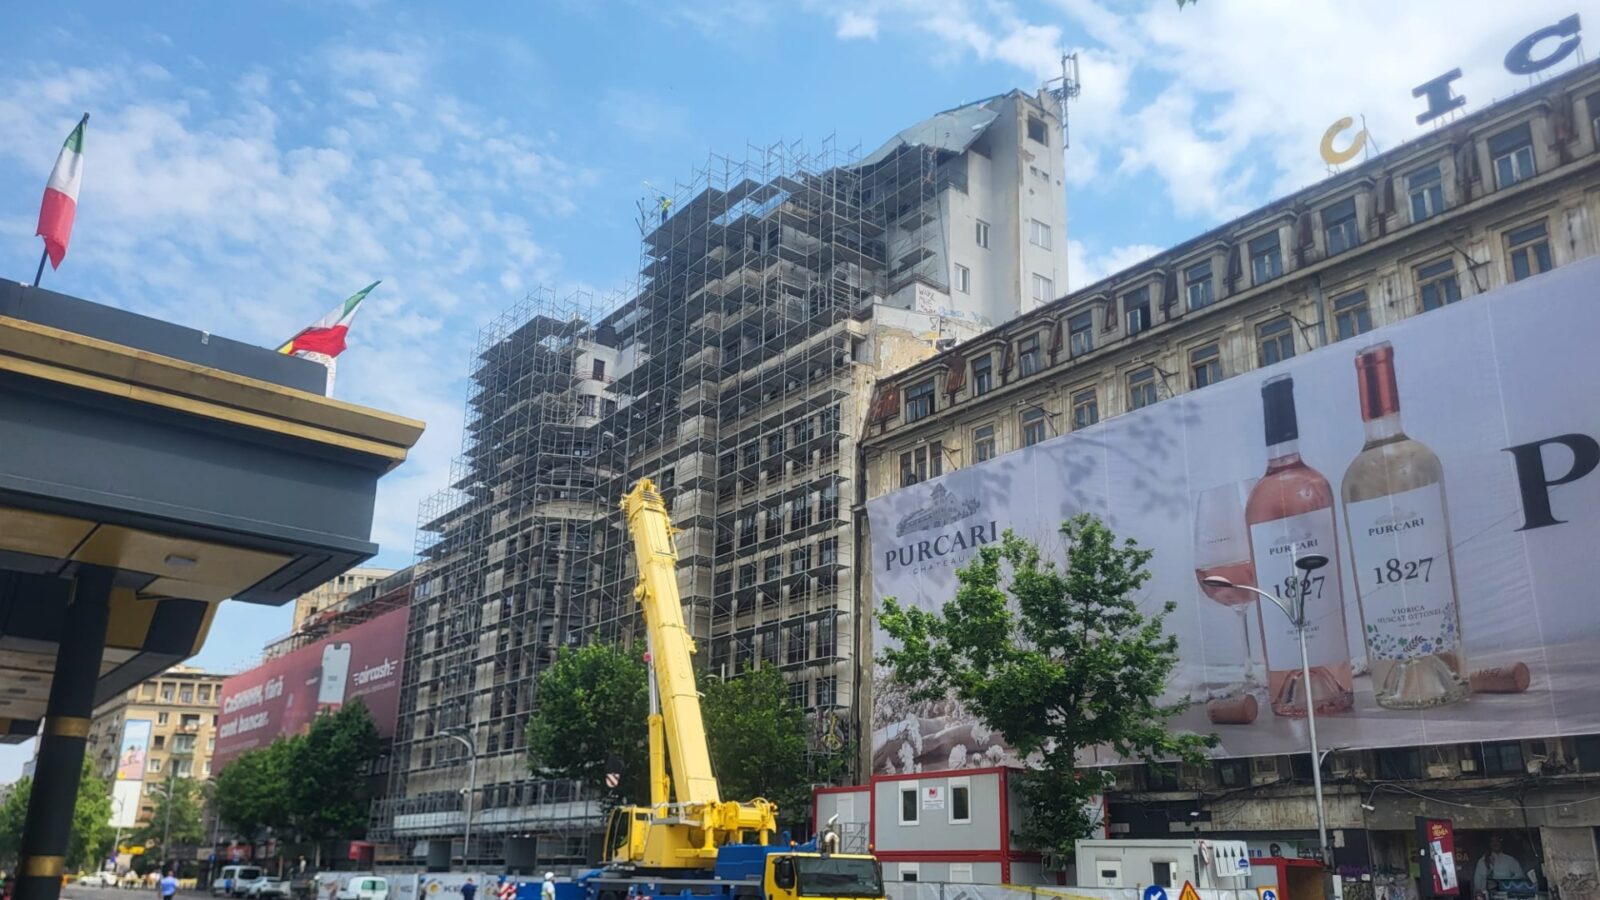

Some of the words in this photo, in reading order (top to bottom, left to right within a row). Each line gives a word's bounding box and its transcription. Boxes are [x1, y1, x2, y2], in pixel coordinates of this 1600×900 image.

[1501, 433, 1600, 532] P
[1368, 517, 1425, 537] PURCARI
[884, 520, 998, 572] PURCARI
[912, 557, 965, 575] CHATEAU
[1374, 557, 1434, 585] 1827
[1273, 575, 1326, 600] 1827
[1391, 604, 1426, 615] VIORICA
[358, 658, 391, 686] aircash
